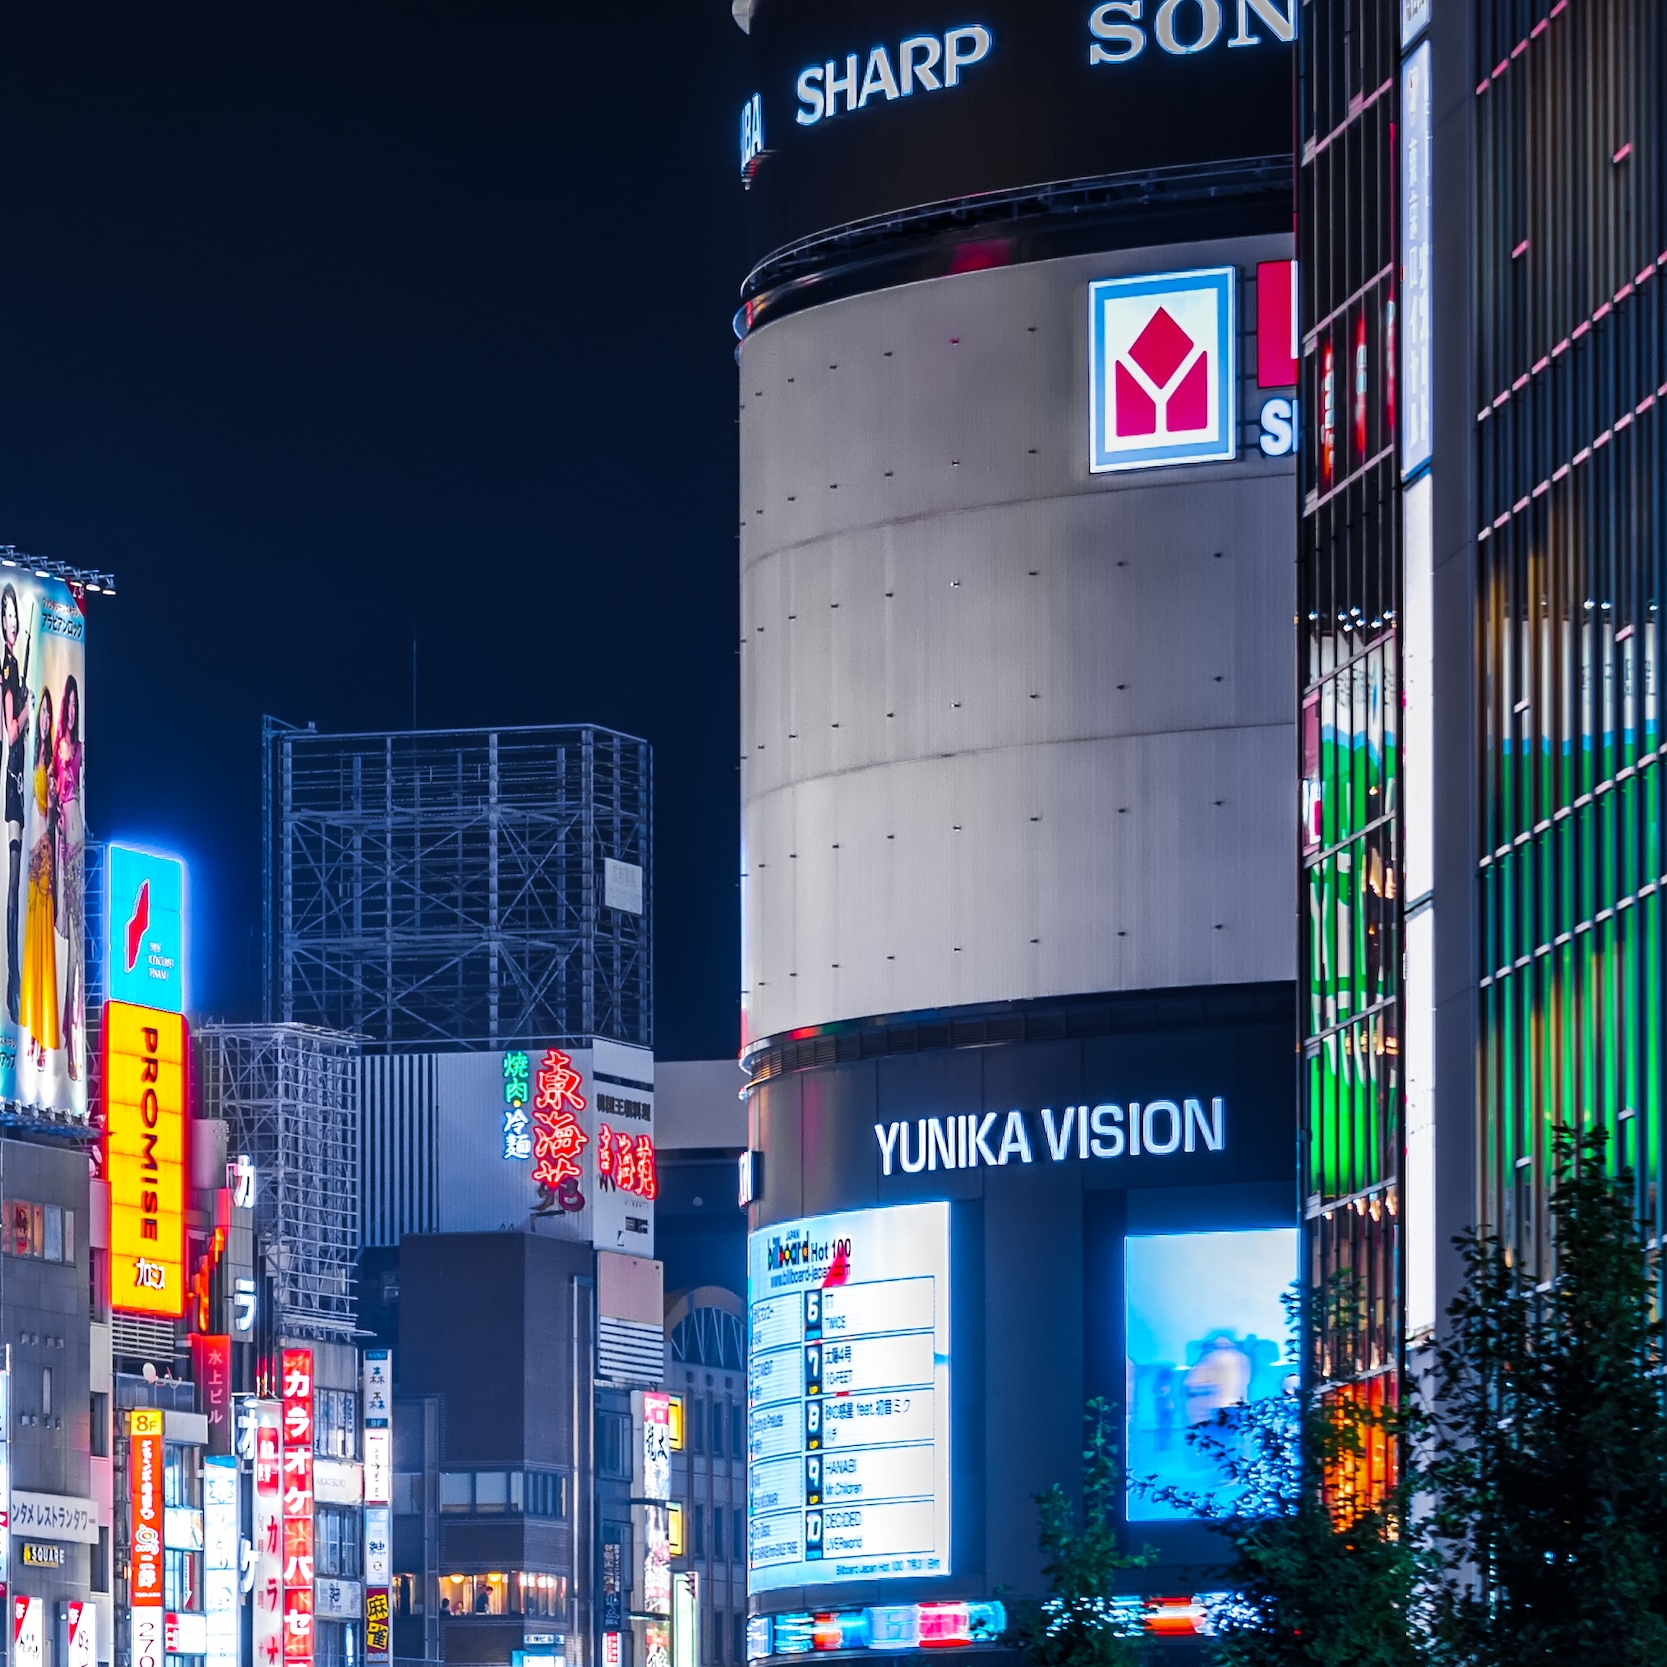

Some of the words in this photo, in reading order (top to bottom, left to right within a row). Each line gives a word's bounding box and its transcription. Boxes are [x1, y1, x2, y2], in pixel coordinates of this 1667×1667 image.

[796, 23, 992, 125] SHARP
[140, 1026, 159, 1241] PROMISE
[874, 1108, 1034, 1176] YUNIKA
[1041, 1096, 1225, 1163] VISION
[811, 1245, 829, 1262] Hot
[831, 1238, 852, 1260] 100
[806, 1294, 819, 1324] 6
[824, 1315, 846, 1330] TWICE
[807, 1349, 819, 1378] 7
[207, 1349, 224, 1425] 水上ビル
[135, 1414, 158, 1433] 8F
[807, 1405, 819, 1433] 8
[808, 1460, 819, 1488] 9
[824, 1458, 857, 1475] HANABI
[806, 1513, 822, 1544] 10
[29, 1546, 65, 1565] SQUARE
[366, 1594, 389, 1651] 麻雀
